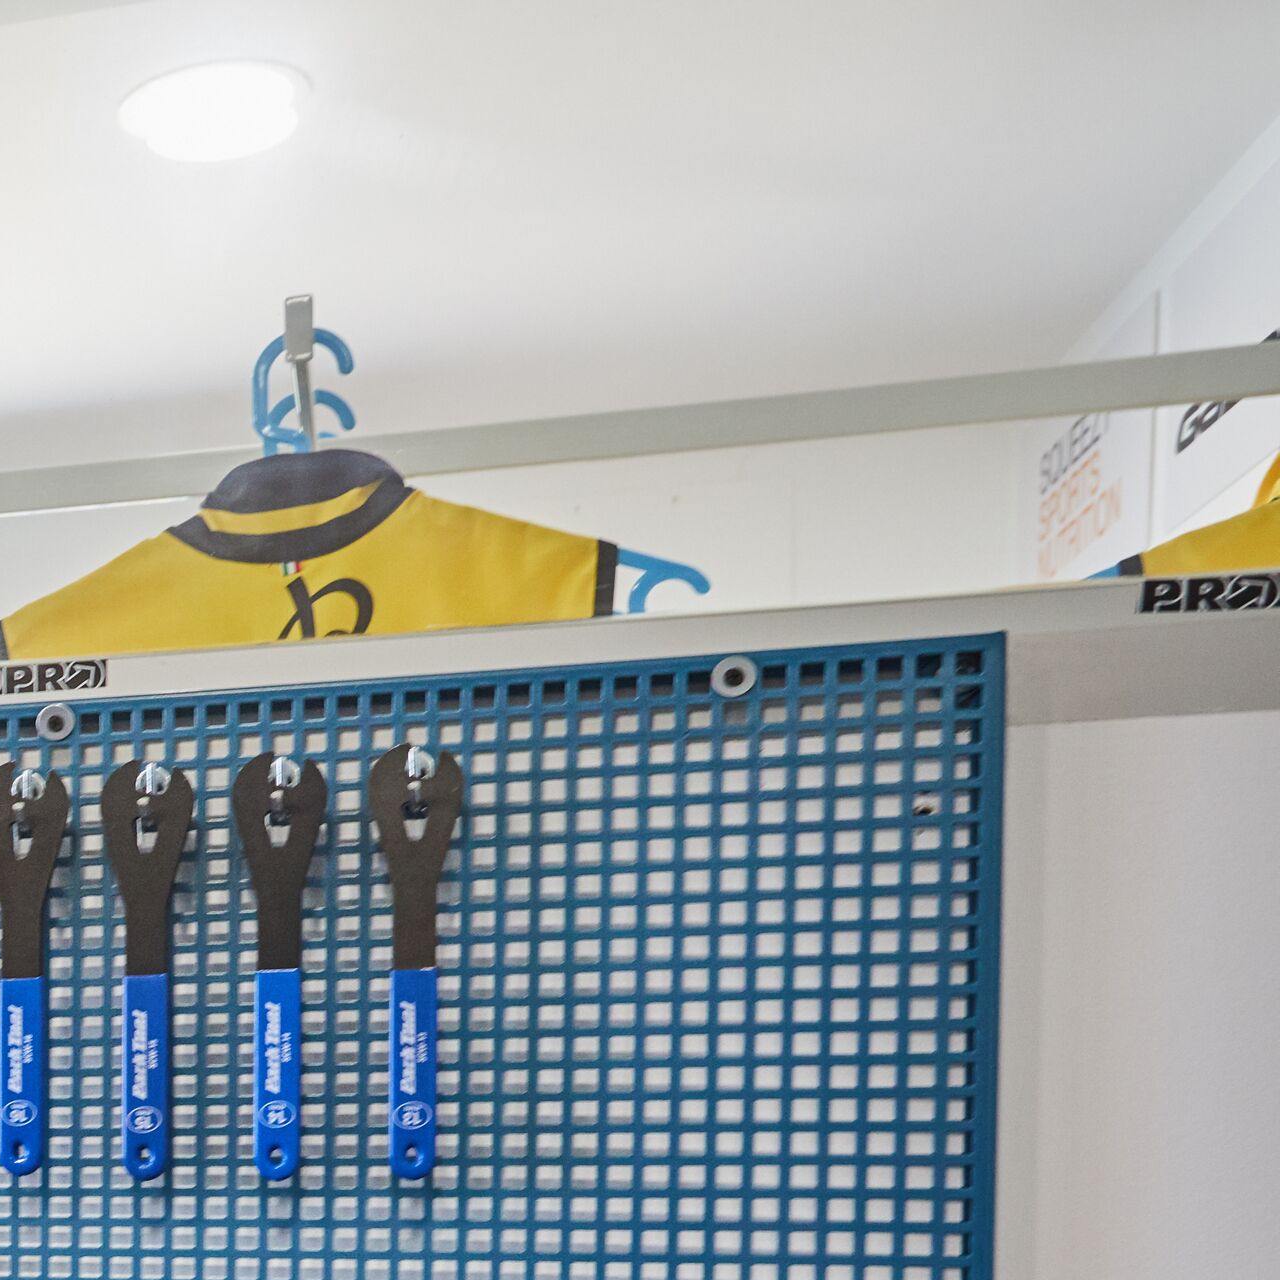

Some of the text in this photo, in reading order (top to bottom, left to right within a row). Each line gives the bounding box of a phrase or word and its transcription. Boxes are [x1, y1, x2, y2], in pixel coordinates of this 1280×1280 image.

[7, 1004, 23, 1046] Tool
[131, 1009, 148, 1052] Tool
[263, 1001, 281, 1095] Park Tool
[399, 1000, 417, 1095] Park Tool
[7, 1048, 23, 1094] Park
[131, 1053, 148, 1101] Park
